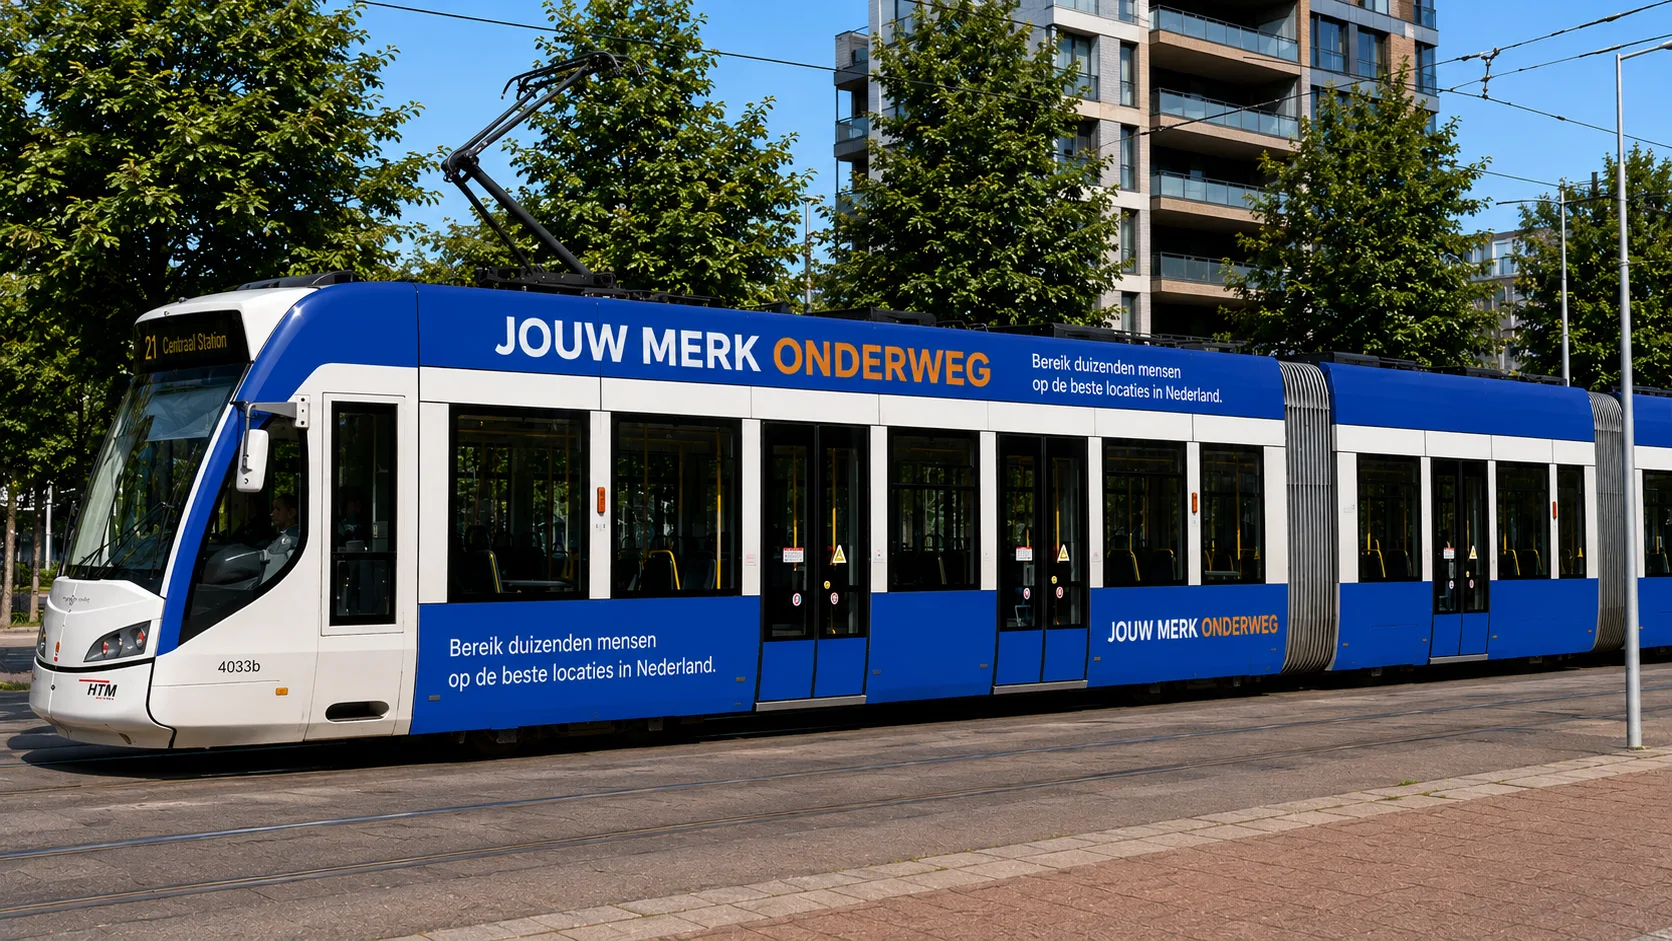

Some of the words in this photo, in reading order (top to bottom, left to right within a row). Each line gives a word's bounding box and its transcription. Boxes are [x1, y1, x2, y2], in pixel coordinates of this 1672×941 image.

[145, 334, 157, 360] 21
[163, 333, 196, 354] Centraal
[197, 331, 227, 350] Station
[495, 315, 628, 362] JOUW
[642, 326, 761, 372] MERK
[773, 337, 991, 388] ONDERWEG
[1032, 353, 1071, 371] Bereik
[1074, 355, 1135, 376] duizenden
[1138, 364, 1181, 379] mensen
[1032, 379, 1049, 395] op
[1051, 376, 1068, 393] de
[1070, 377, 1103, 396] beste
[1106, 380, 1150, 399] locaties
[1152, 384, 1163, 399] in
[1165, 385, 1223, 403] Nederland.
[1107, 619, 1154, 643] JOUW
[1157, 617, 1199, 640] MERK
[1201, 614, 1279, 638] ONDERWEG
[449, 635, 504, 657] Bereik
[508, 633, 592, 655] duizenden
[597, 634, 657, 651] mensen
[217, 659, 261, 674] 4033b
[448, 672, 471, 692] op
[475, 666, 497, 687] de
[502, 665, 548, 685] beste
[553, 661, 614, 682] locaties
[618, 659, 632, 678] in
[637, 655, 716, 677] Nederland.
[87, 683, 118, 698] HTM
